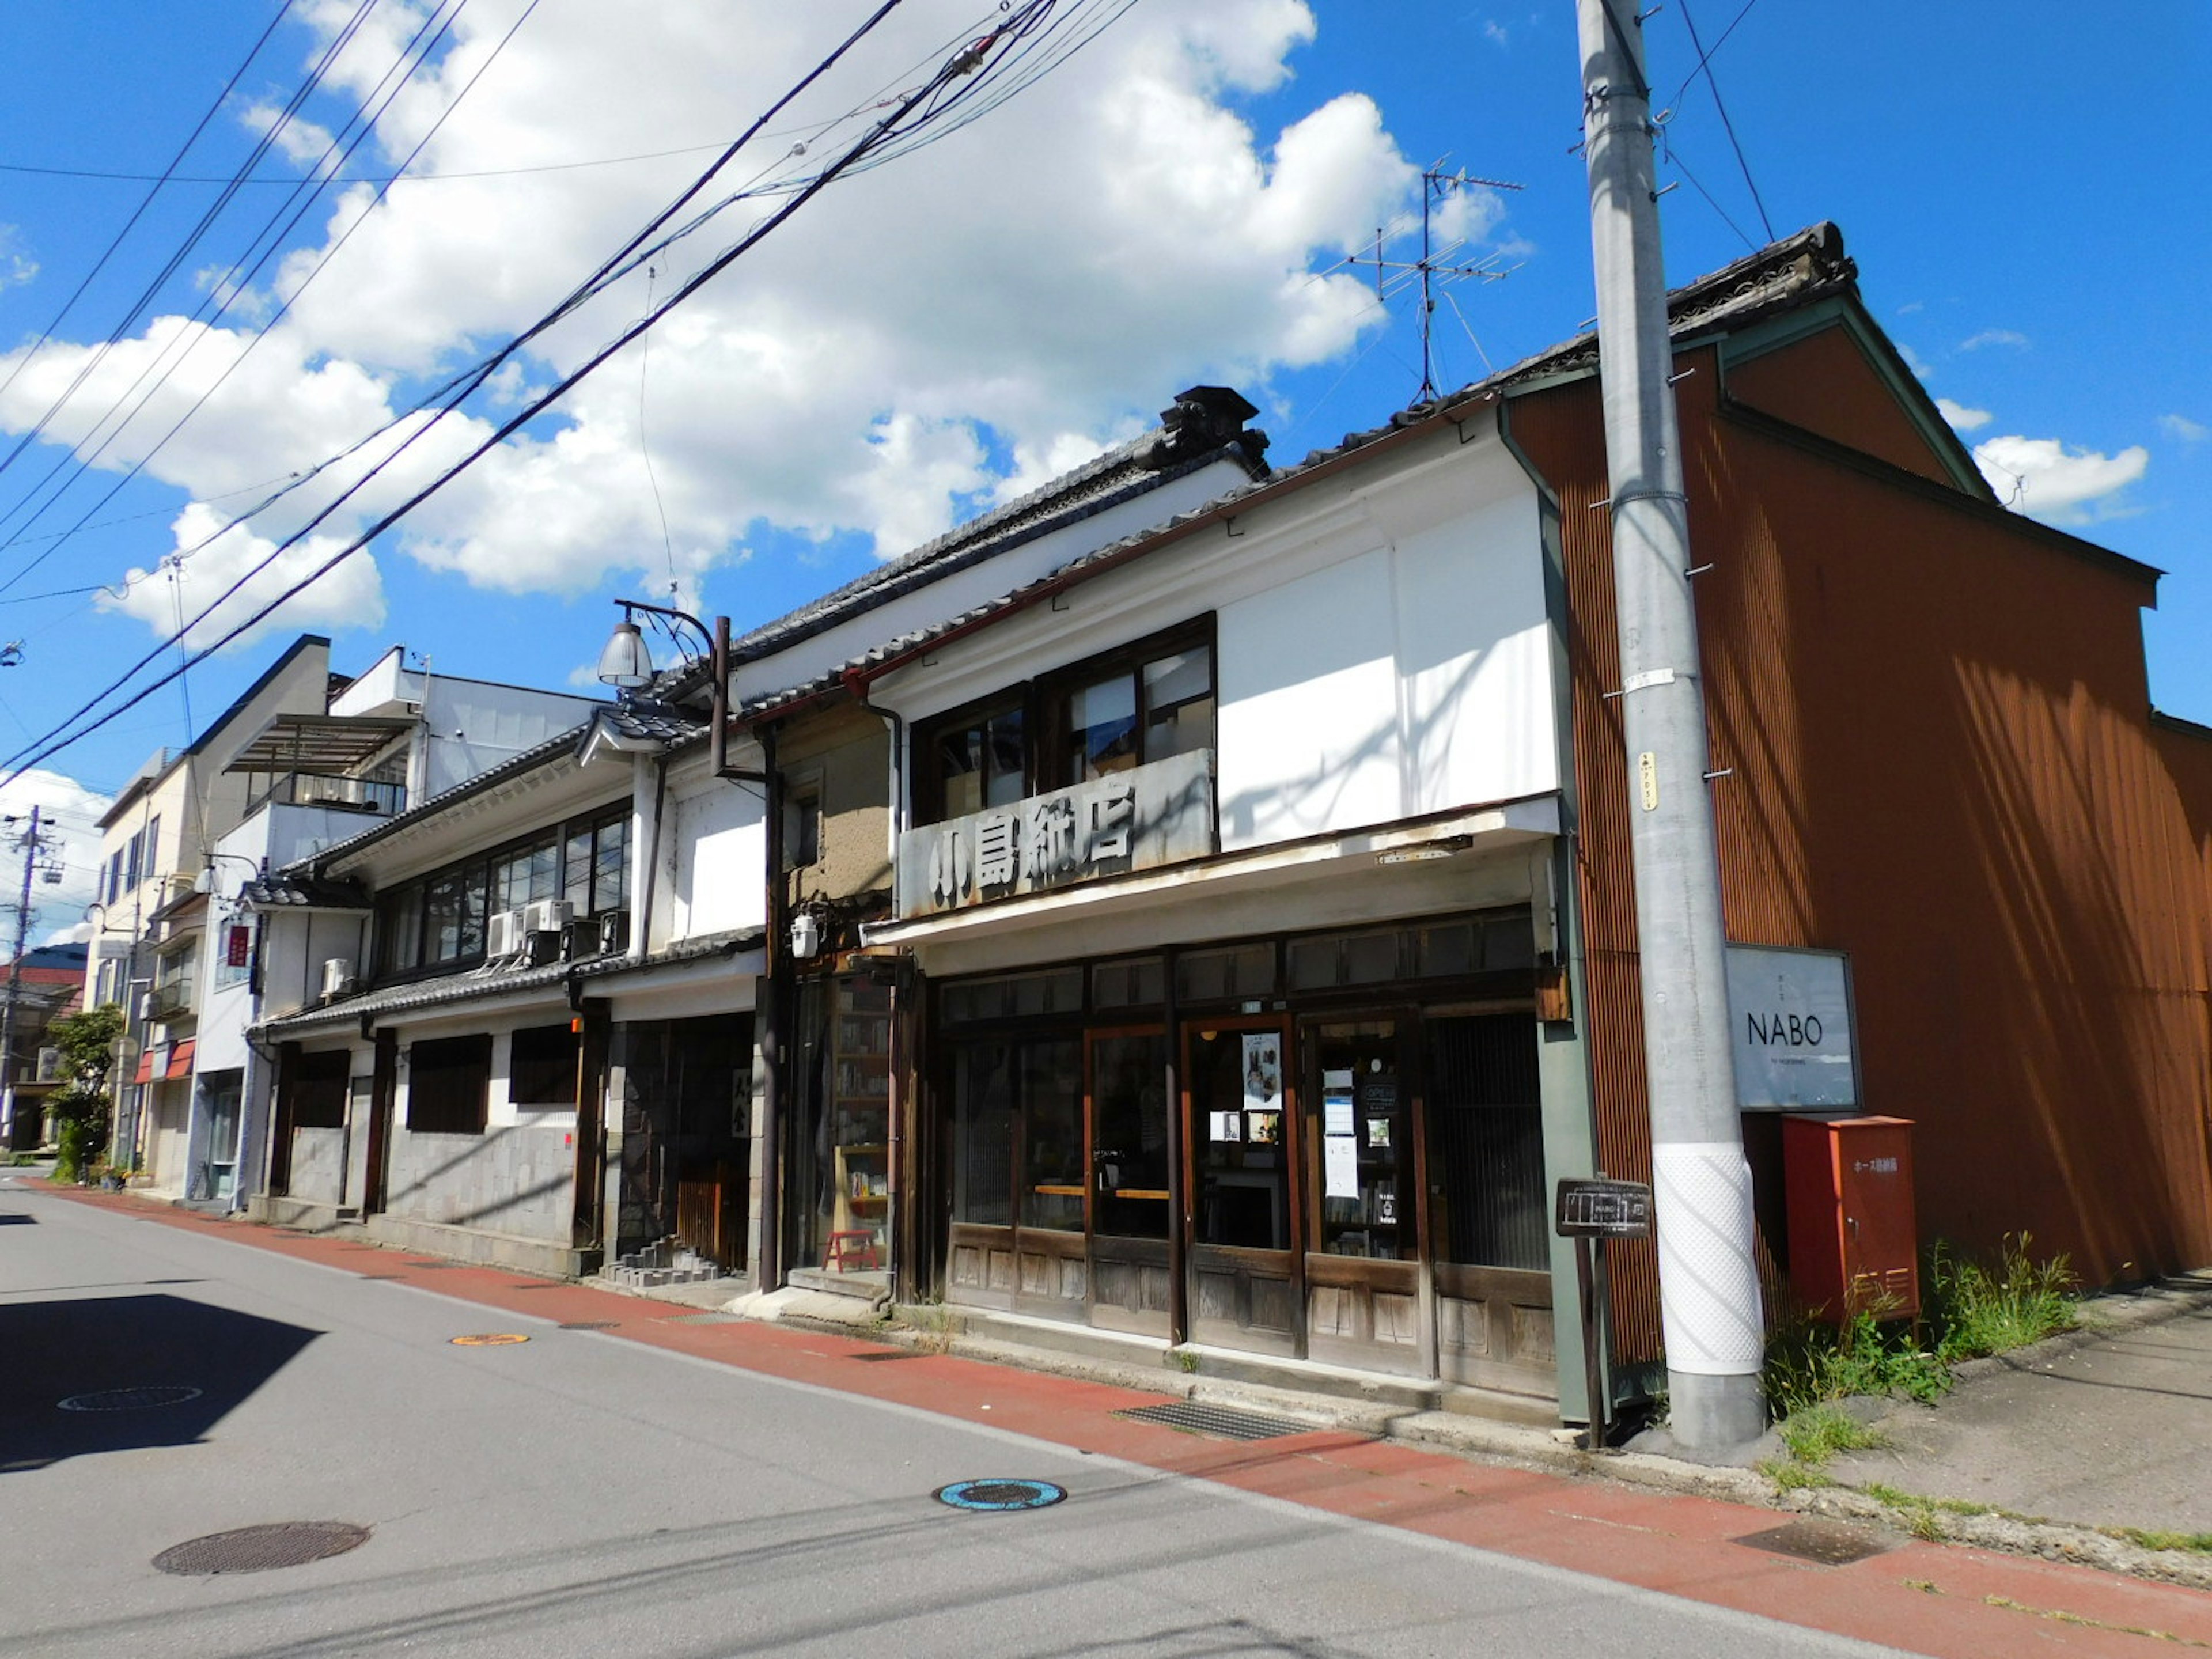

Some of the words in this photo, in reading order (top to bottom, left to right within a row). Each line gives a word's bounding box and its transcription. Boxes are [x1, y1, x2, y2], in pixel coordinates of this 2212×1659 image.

[929, 779, 1134, 897] 小島紙店
[1748, 1012, 1822, 1046] NABO
